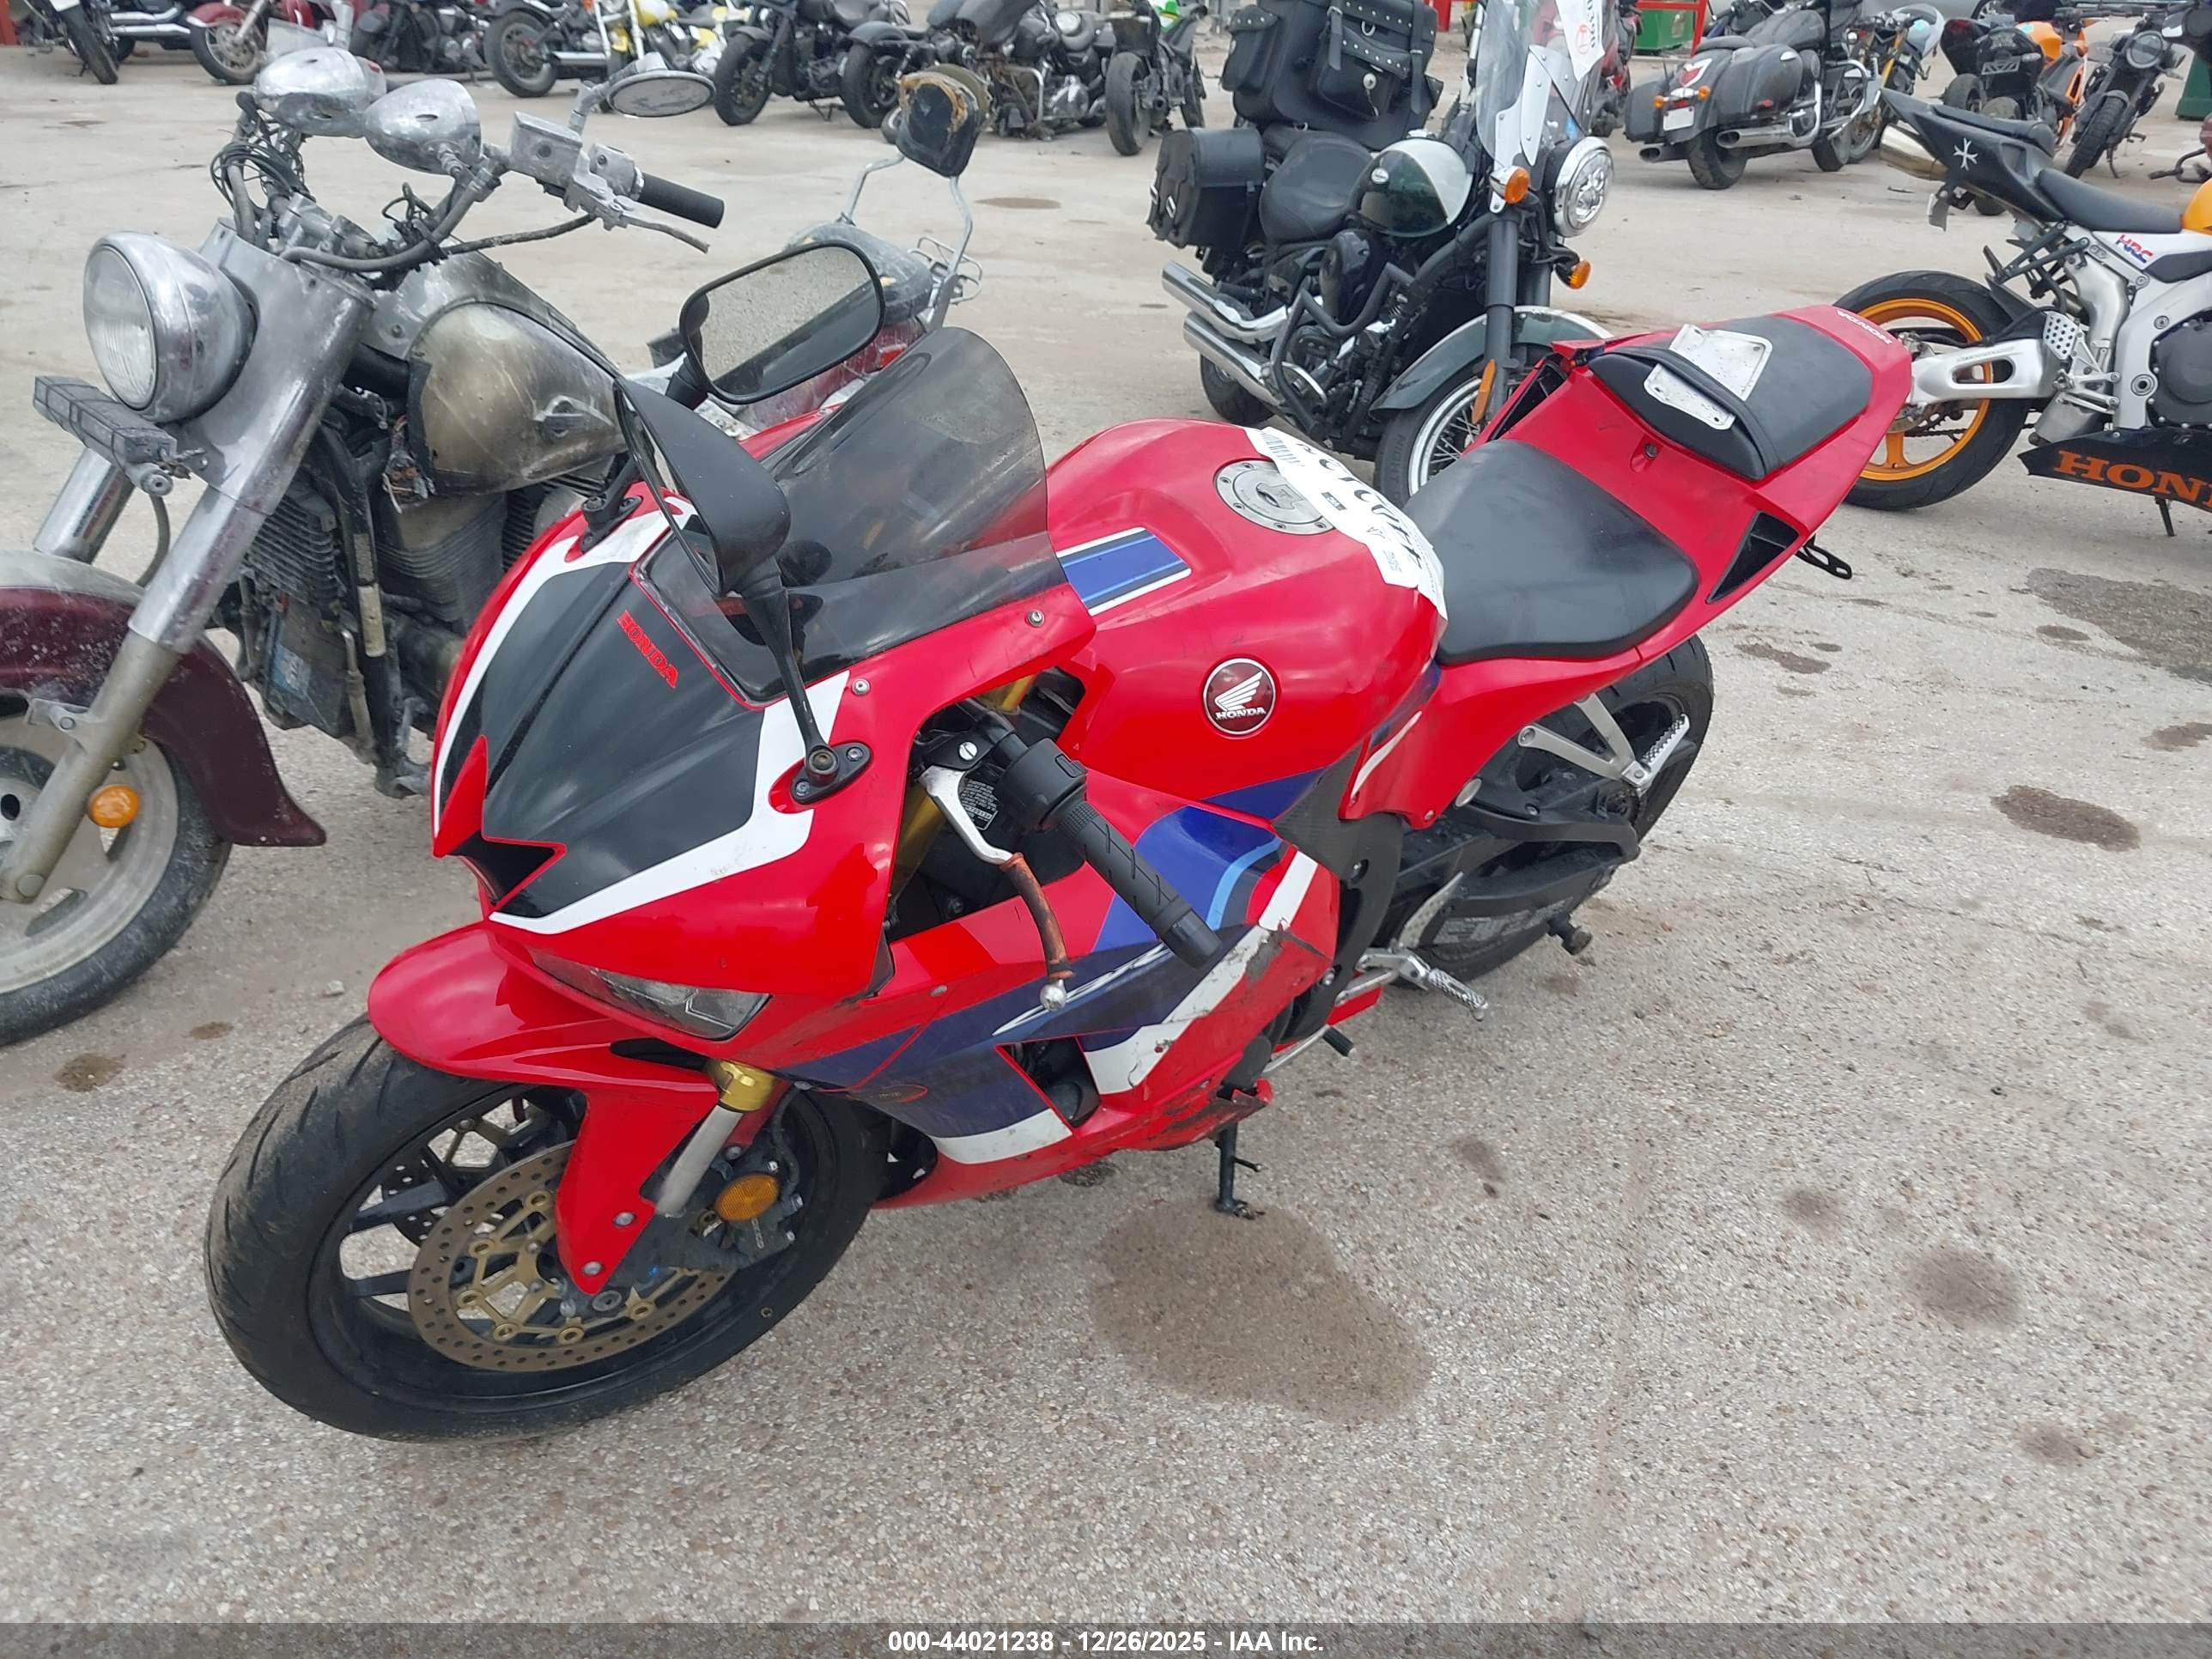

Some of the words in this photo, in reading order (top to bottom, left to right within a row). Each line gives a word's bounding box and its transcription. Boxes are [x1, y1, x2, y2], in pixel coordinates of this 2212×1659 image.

[2115, 234, 2154, 264] HRC
[1836, 309, 1893, 344] HONDA
[2053, 449, 2212, 509] HON
[617, 610, 678, 689] HONDA
[1215, 707, 1267, 720] HONDA
